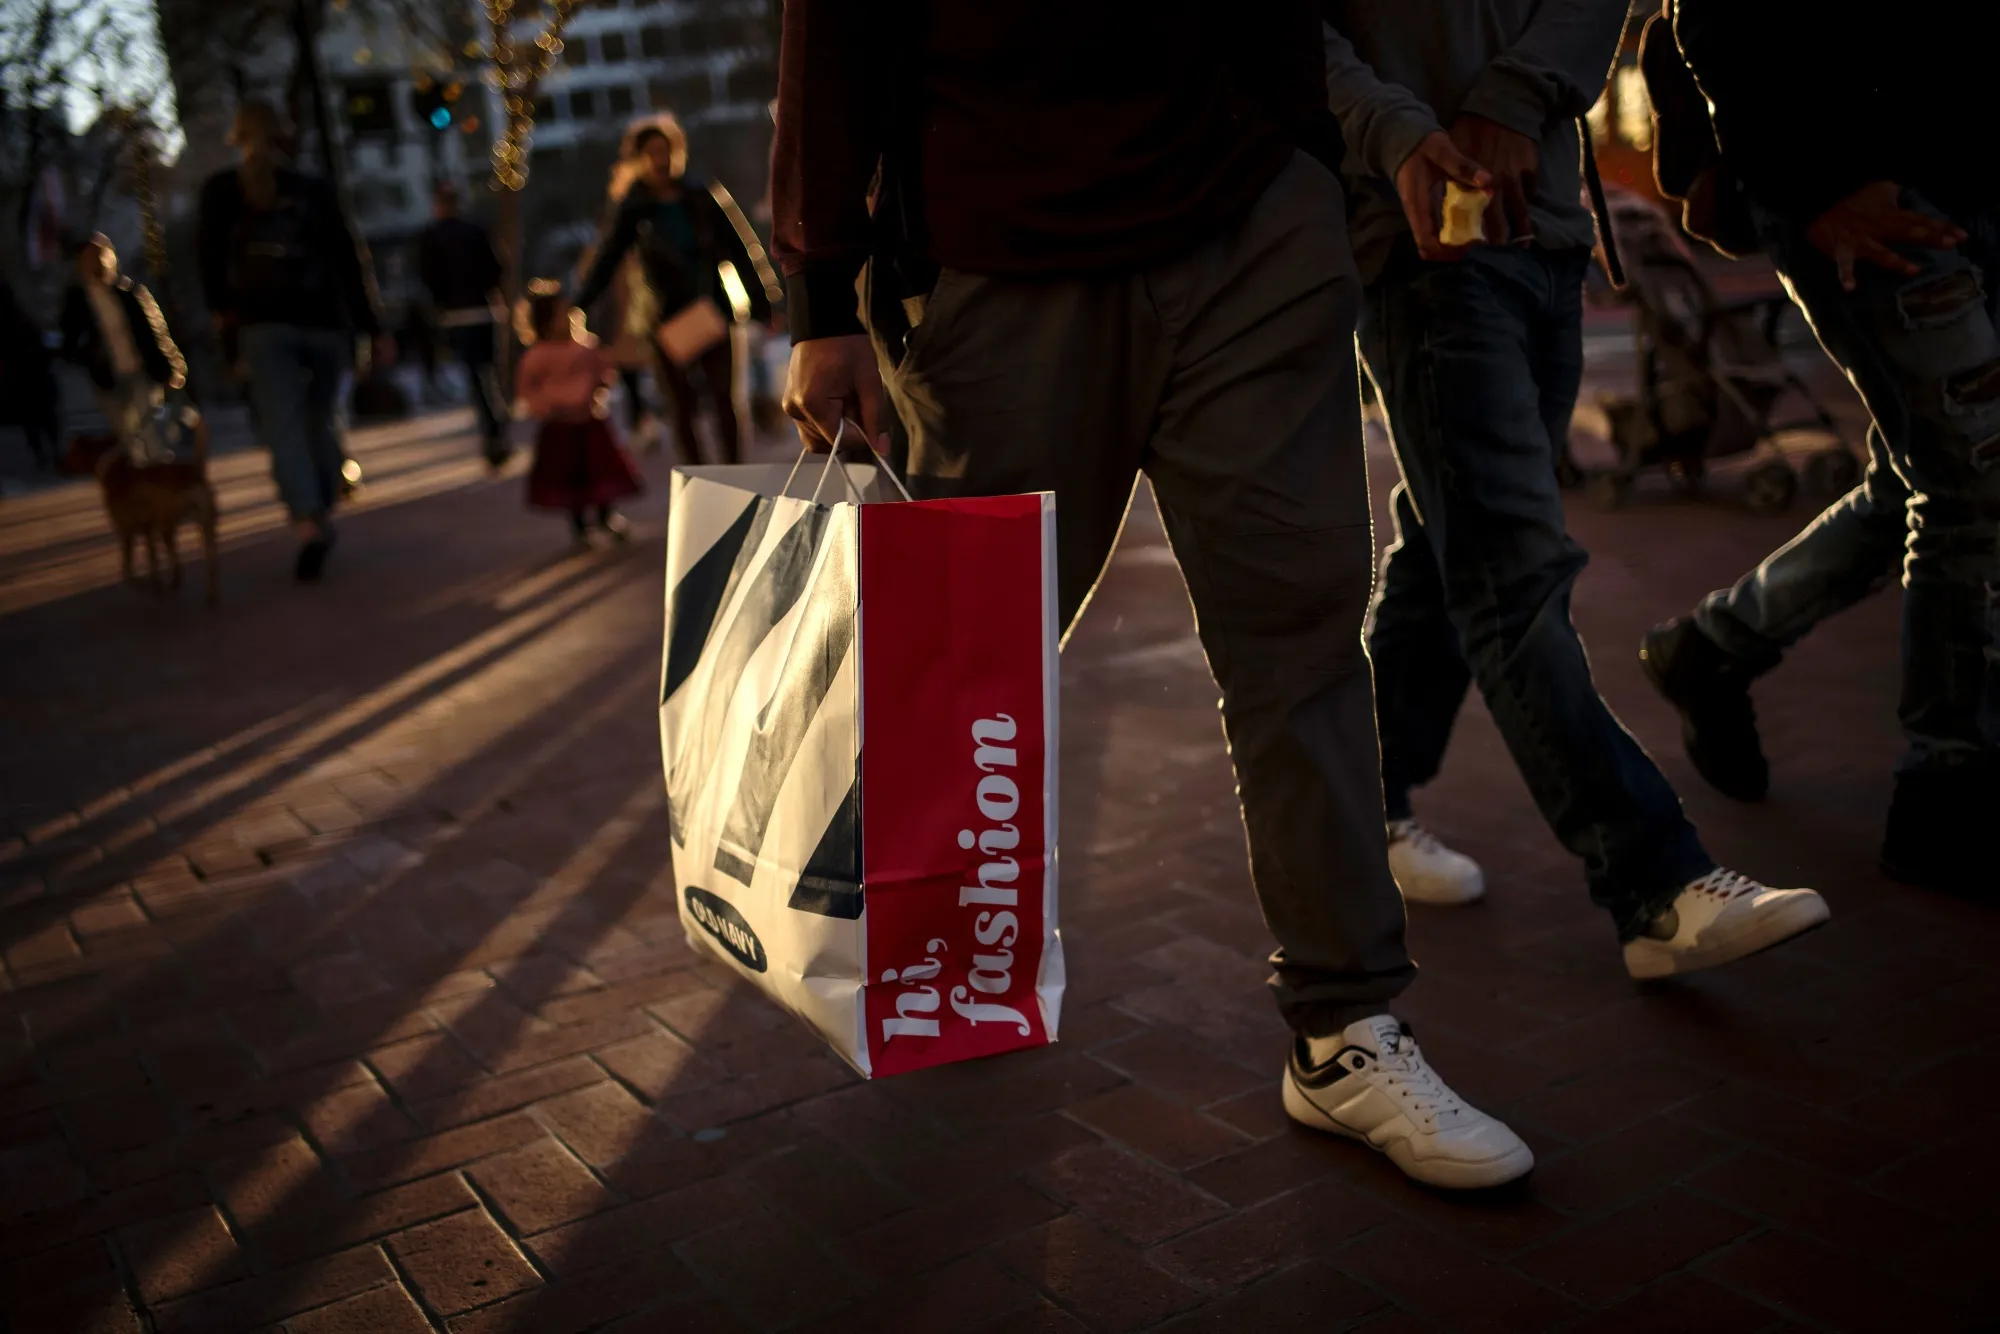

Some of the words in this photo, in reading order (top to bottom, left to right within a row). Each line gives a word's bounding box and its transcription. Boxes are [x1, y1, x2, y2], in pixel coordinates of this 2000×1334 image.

[950, 712, 1031, 1037] fashion
[691, 896, 719, 934] OLD
[716, 914, 757, 962] NAVY
[881, 938, 948, 1043] hi,
